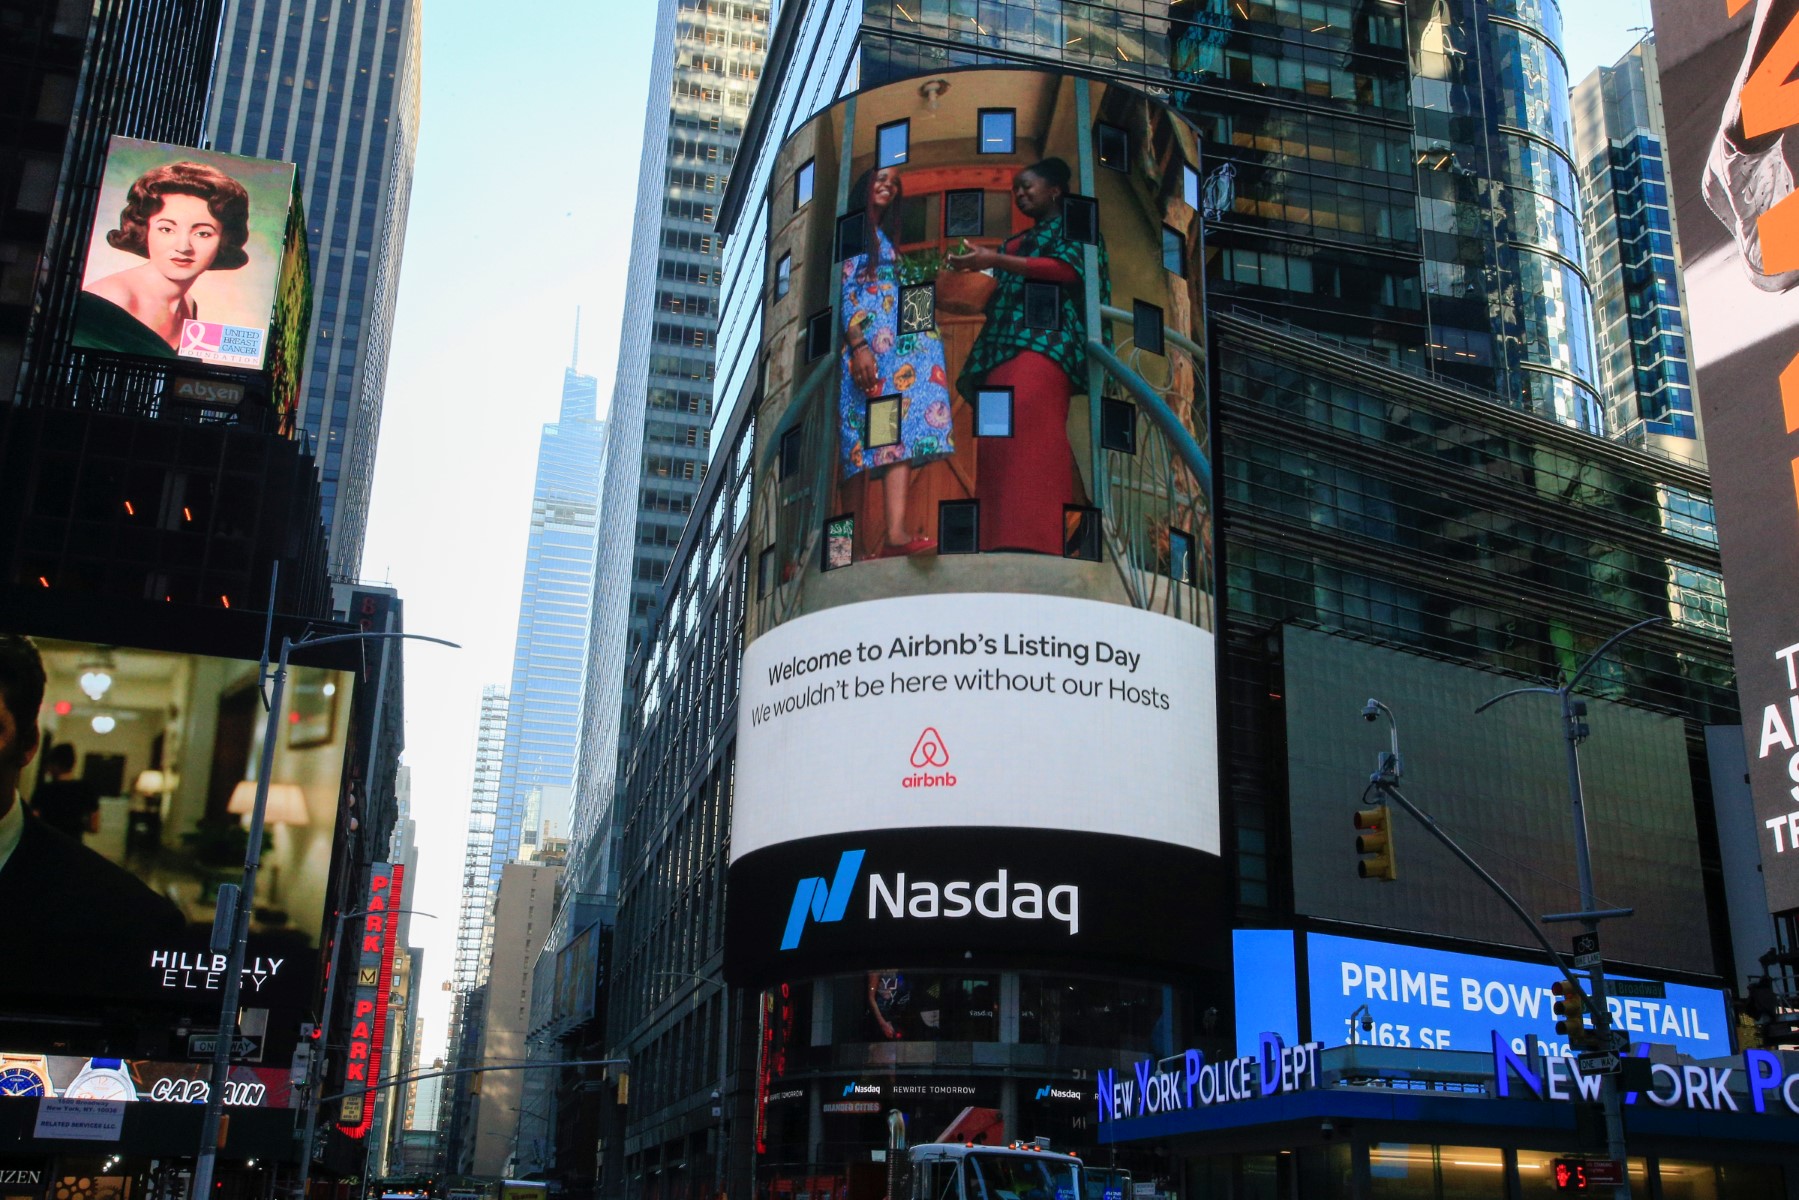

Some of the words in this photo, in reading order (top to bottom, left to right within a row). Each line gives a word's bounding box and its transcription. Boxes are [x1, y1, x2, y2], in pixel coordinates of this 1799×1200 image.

[223, 337, 258, 347] BREAST
[225, 328, 260, 339] UNITED
[180, 349, 259, 364] FOUNDATION
[221, 345, 257, 355] CANCER
[178, 382, 239, 401] Absen
[768, 649, 852, 687] Welcome
[856, 642, 883, 662] to
[888, 633, 998, 660] Airbnb's
[1003, 633, 1090, 666] Listing
[1095, 641, 1141, 673] Day
[751, 705, 771, 728] We
[773, 679, 850, 717] wouldn't
[854, 675, 885, 698] be
[890, 671, 948, 694] here
[954, 668, 1056, 694] without
[1061, 679, 1103, 698] our
[1108, 680, 1170, 711] Hosts
[901, 772, 957, 788] airbnb
[868, 868, 1080, 936] Nasdaq
[363, 876, 388, 953] PARK
[151, 950, 284, 975] HILLBLY
[1618, 982, 1663, 996] Broadway
[1341, 961, 1451, 1008] PRIME
[1606, 996, 1710, 1041] RETAIL
[347, 1000, 373, 1081] PARK
[1491, 1029, 1602, 1100] NEW
[1581, 1060, 1594, 1069] ONE
[1601, 1057, 1615, 1067] WAY
[1097, 1068, 1134, 1122] NEW
[1134, 1059, 1182, 1116] YORK
[1185, 1049, 1254, 1109] POLICE
[1258, 1031, 1324, 1096] DEPT
[151, 1077, 266, 1106] CAPAIN
[855, 1085, 881, 1095] Nasdaq
[930, 1086, 976, 1094] TOMORROW
[1051, 1088, 1081, 1100] Nasdaq
[823, 1103, 853, 1112] BRANDED
[854, 1102, 880, 1112] CITIES
[1577, 1166, 1586, 1188] 5
